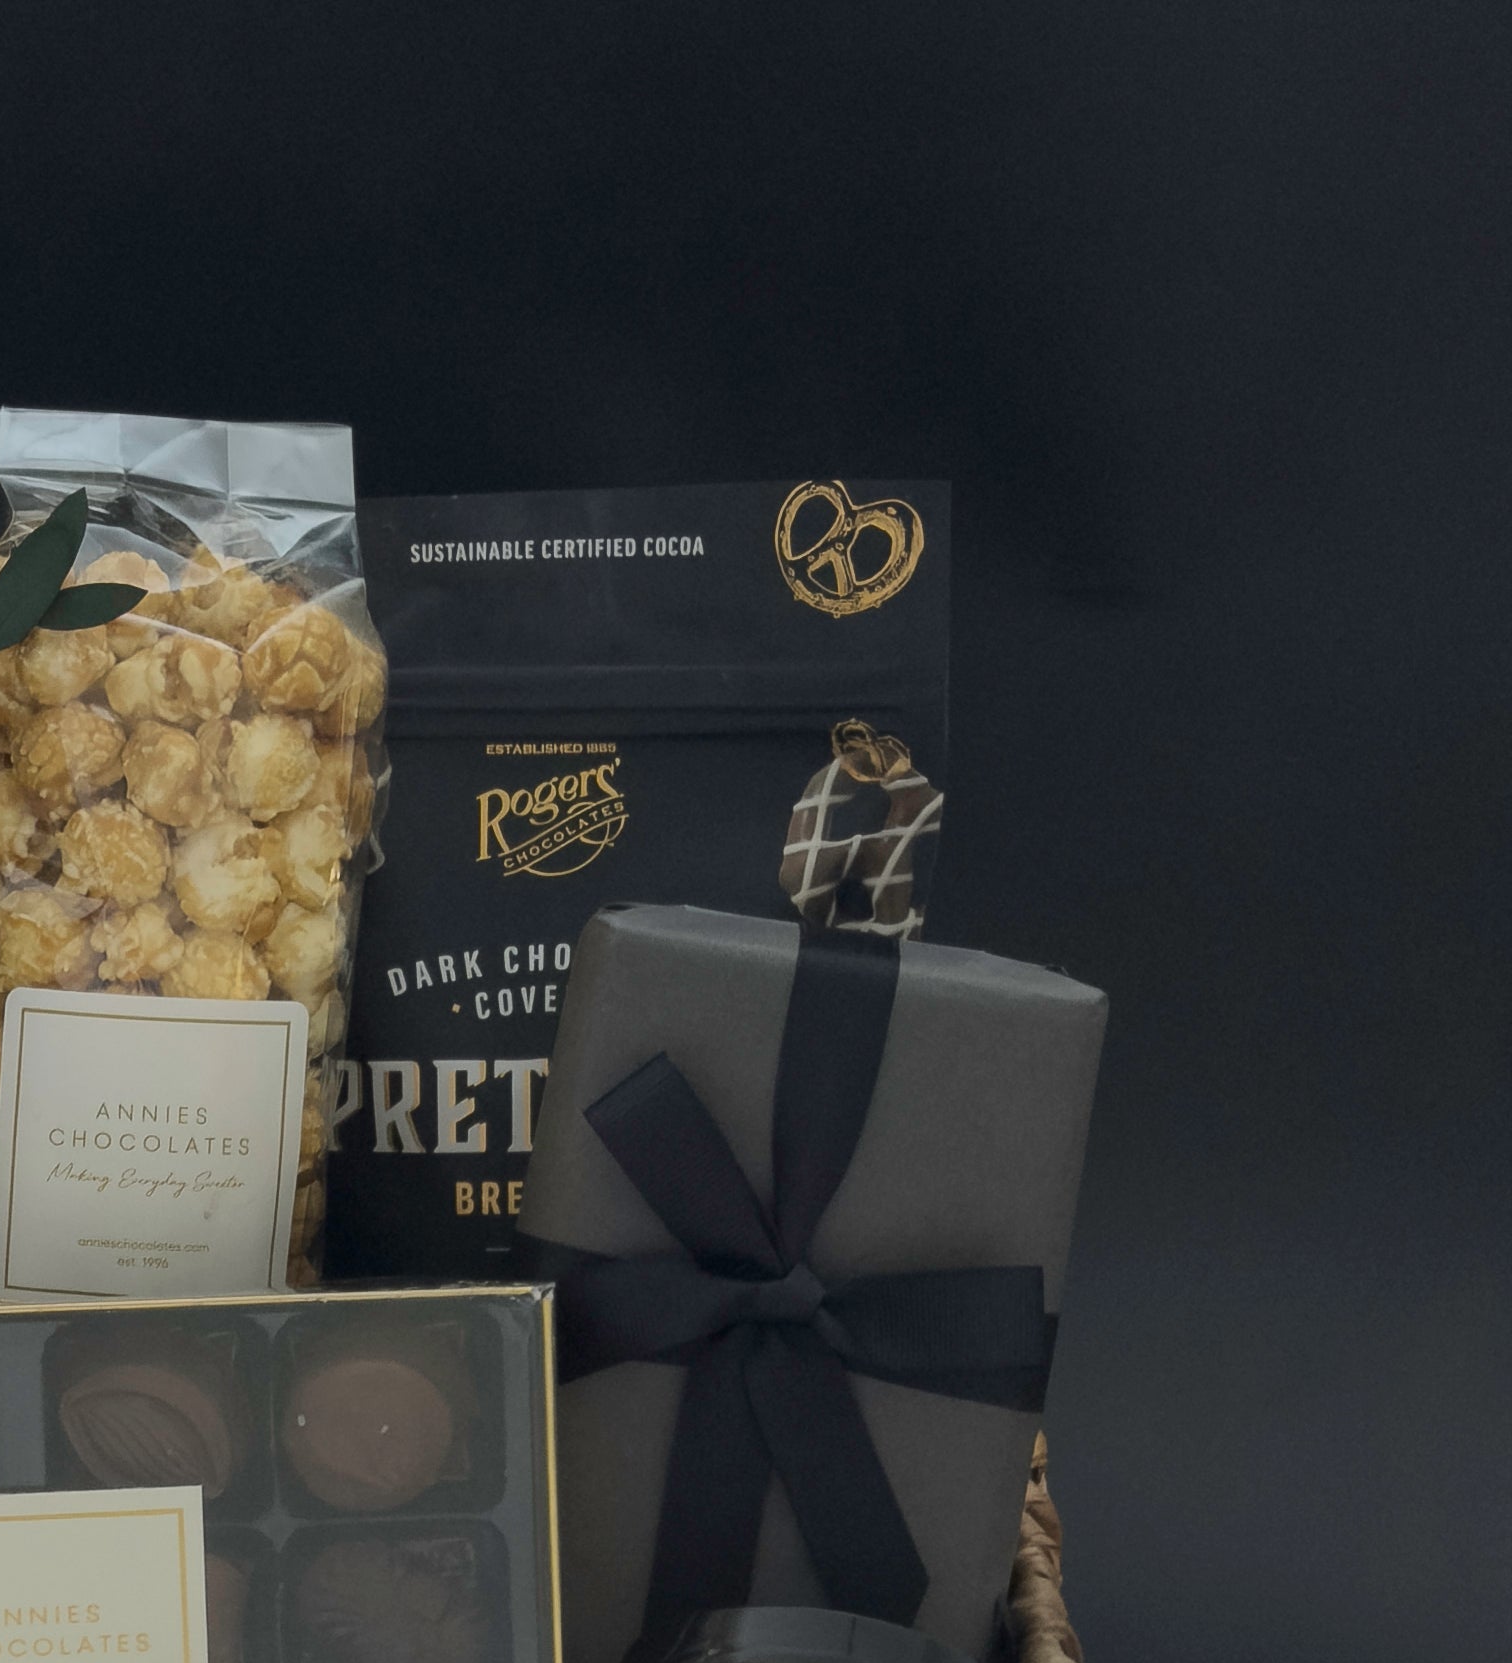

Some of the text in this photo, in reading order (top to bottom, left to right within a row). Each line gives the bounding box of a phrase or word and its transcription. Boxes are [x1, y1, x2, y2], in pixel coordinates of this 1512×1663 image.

[410, 536, 704, 563] SUSTAINABLE CERTIFIED COCOA
[486, 744, 583, 755] ESTABLISHED
[504, 802, 624, 868] CHOCOLATES
[388, 943, 571, 996] DARK CHO
[475, 985, 557, 1019] COVE
[96, 1102, 208, 1125] ANNIES
[49, 1128, 250, 1156] CHOCOLATES
[46, 1162, 110, 1193] Making
[118, 1168, 186, 1199] Everyday
[142, 1256, 169, 1269] 1996
